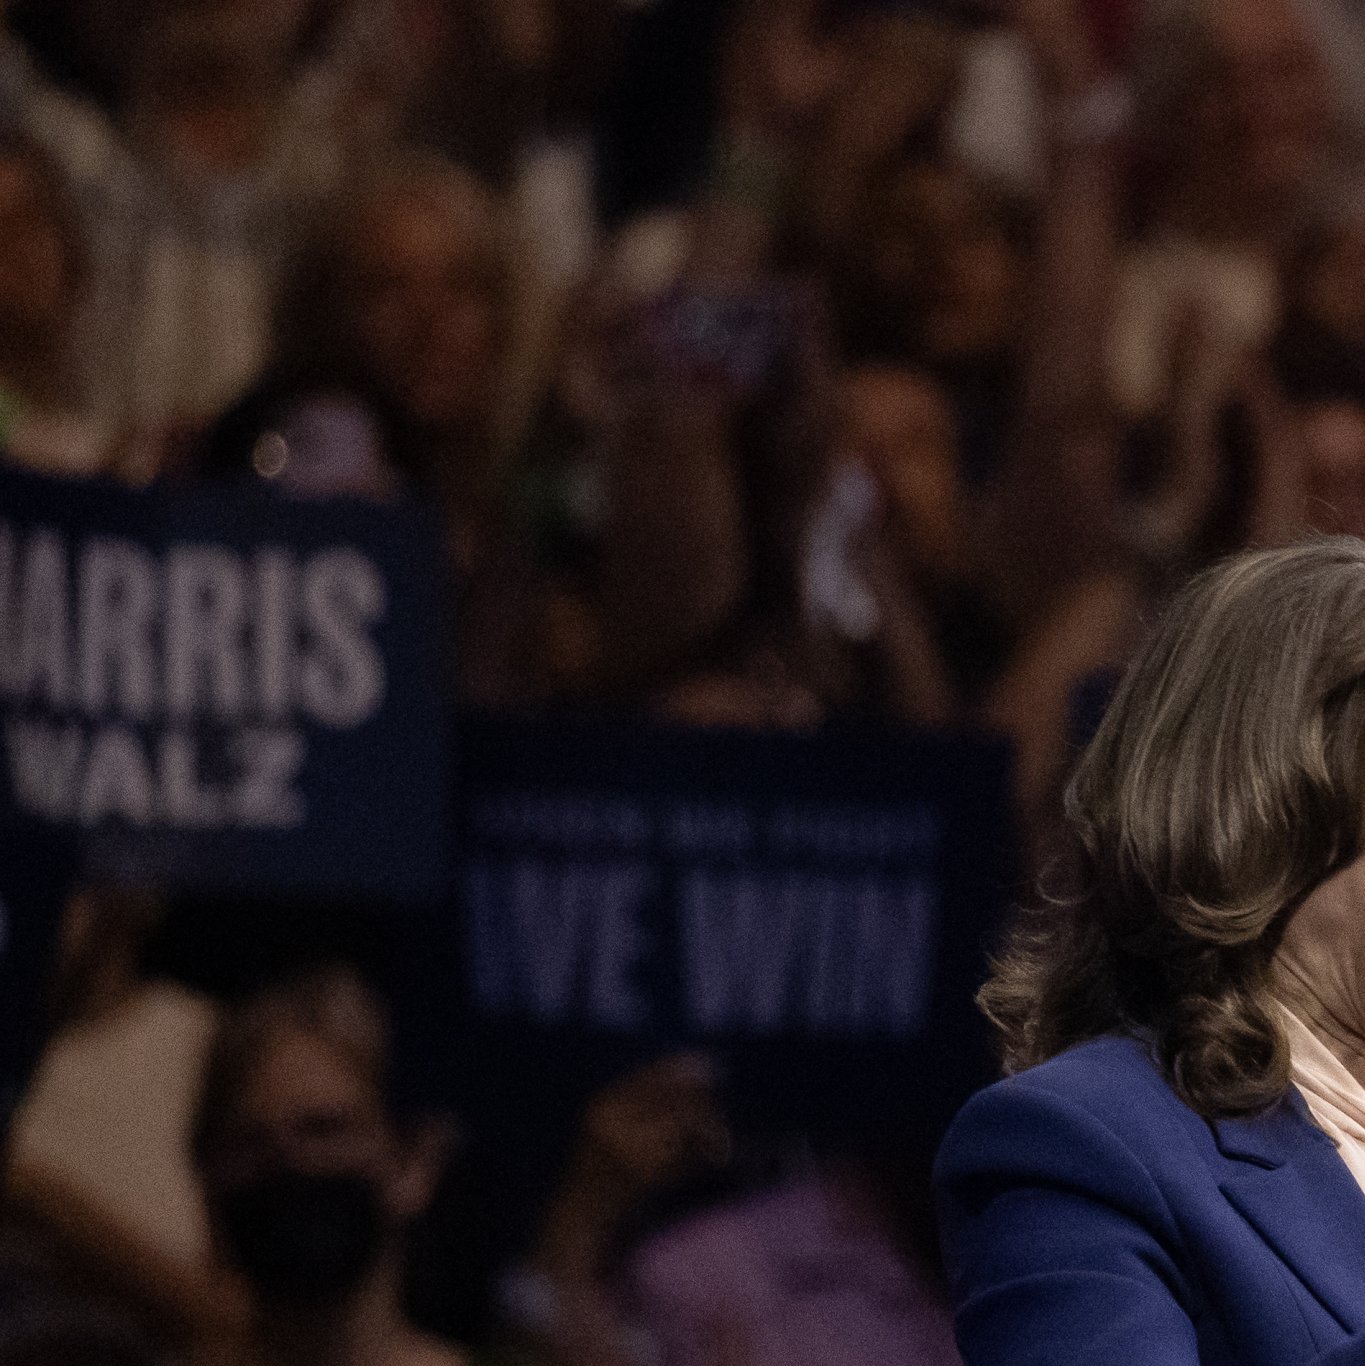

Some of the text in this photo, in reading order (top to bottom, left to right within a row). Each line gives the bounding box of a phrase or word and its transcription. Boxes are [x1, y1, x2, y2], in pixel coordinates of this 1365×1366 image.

[0, 522, 388, 728] ARRIS
[6, 722, 306, 828] WALZ
[466, 862, 934, 1040] WE WIN
